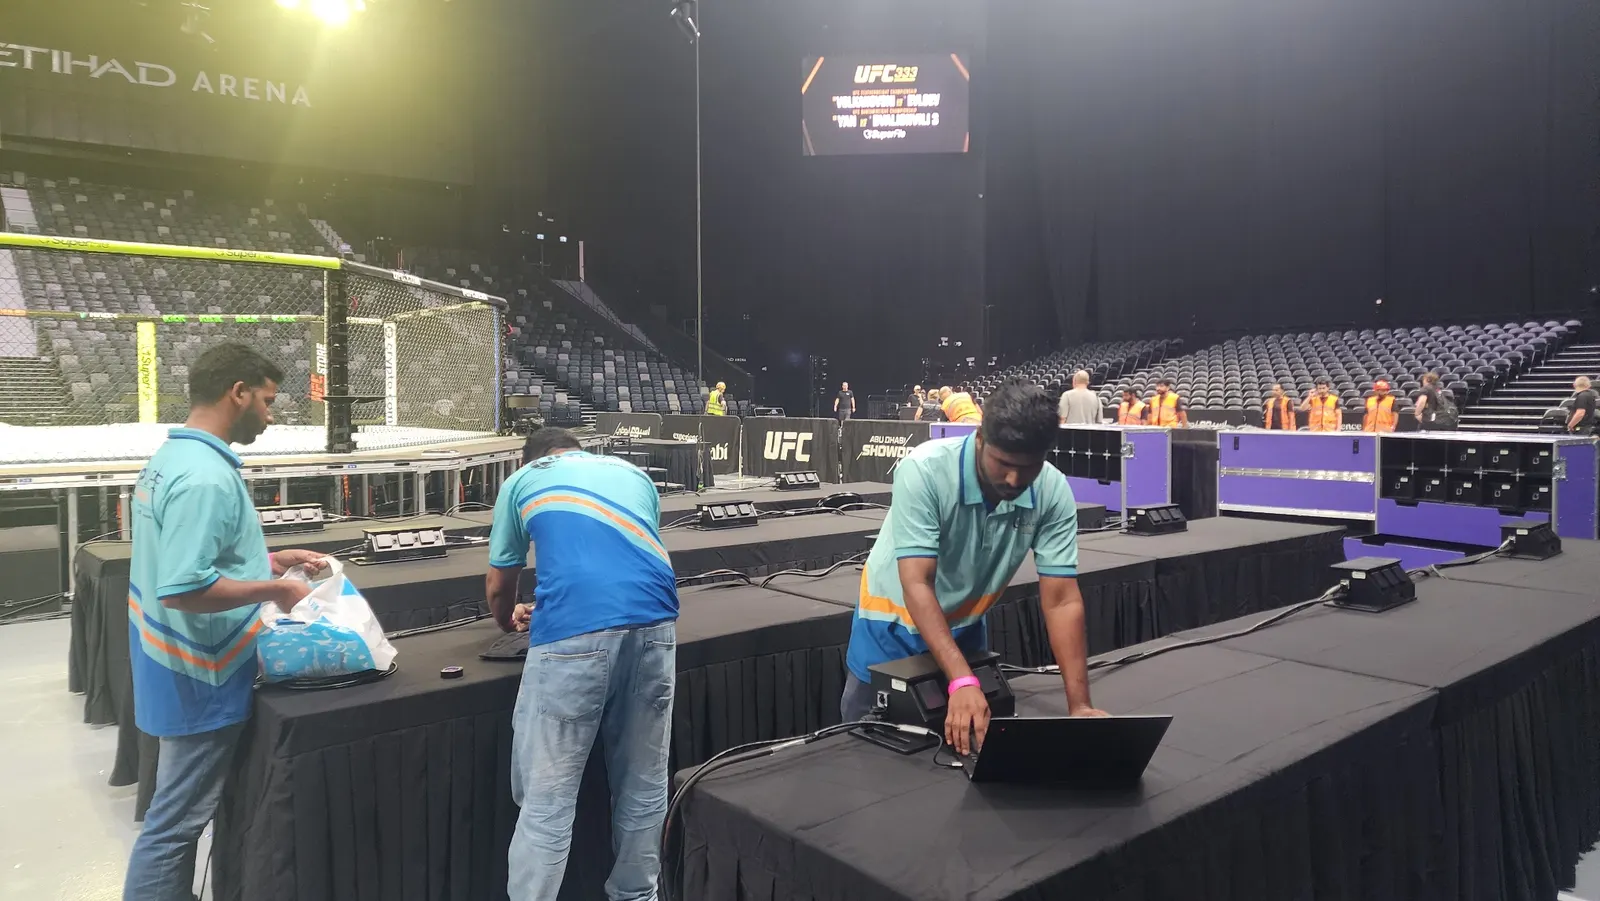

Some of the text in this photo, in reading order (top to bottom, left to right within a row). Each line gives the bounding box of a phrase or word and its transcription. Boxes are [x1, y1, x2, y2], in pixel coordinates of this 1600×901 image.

[854, 65, 897, 83] UFC
[191, 70, 312, 107] ARENA
[763, 430, 813, 462] UFC
[869, 435, 907, 445] ABU DHABI
